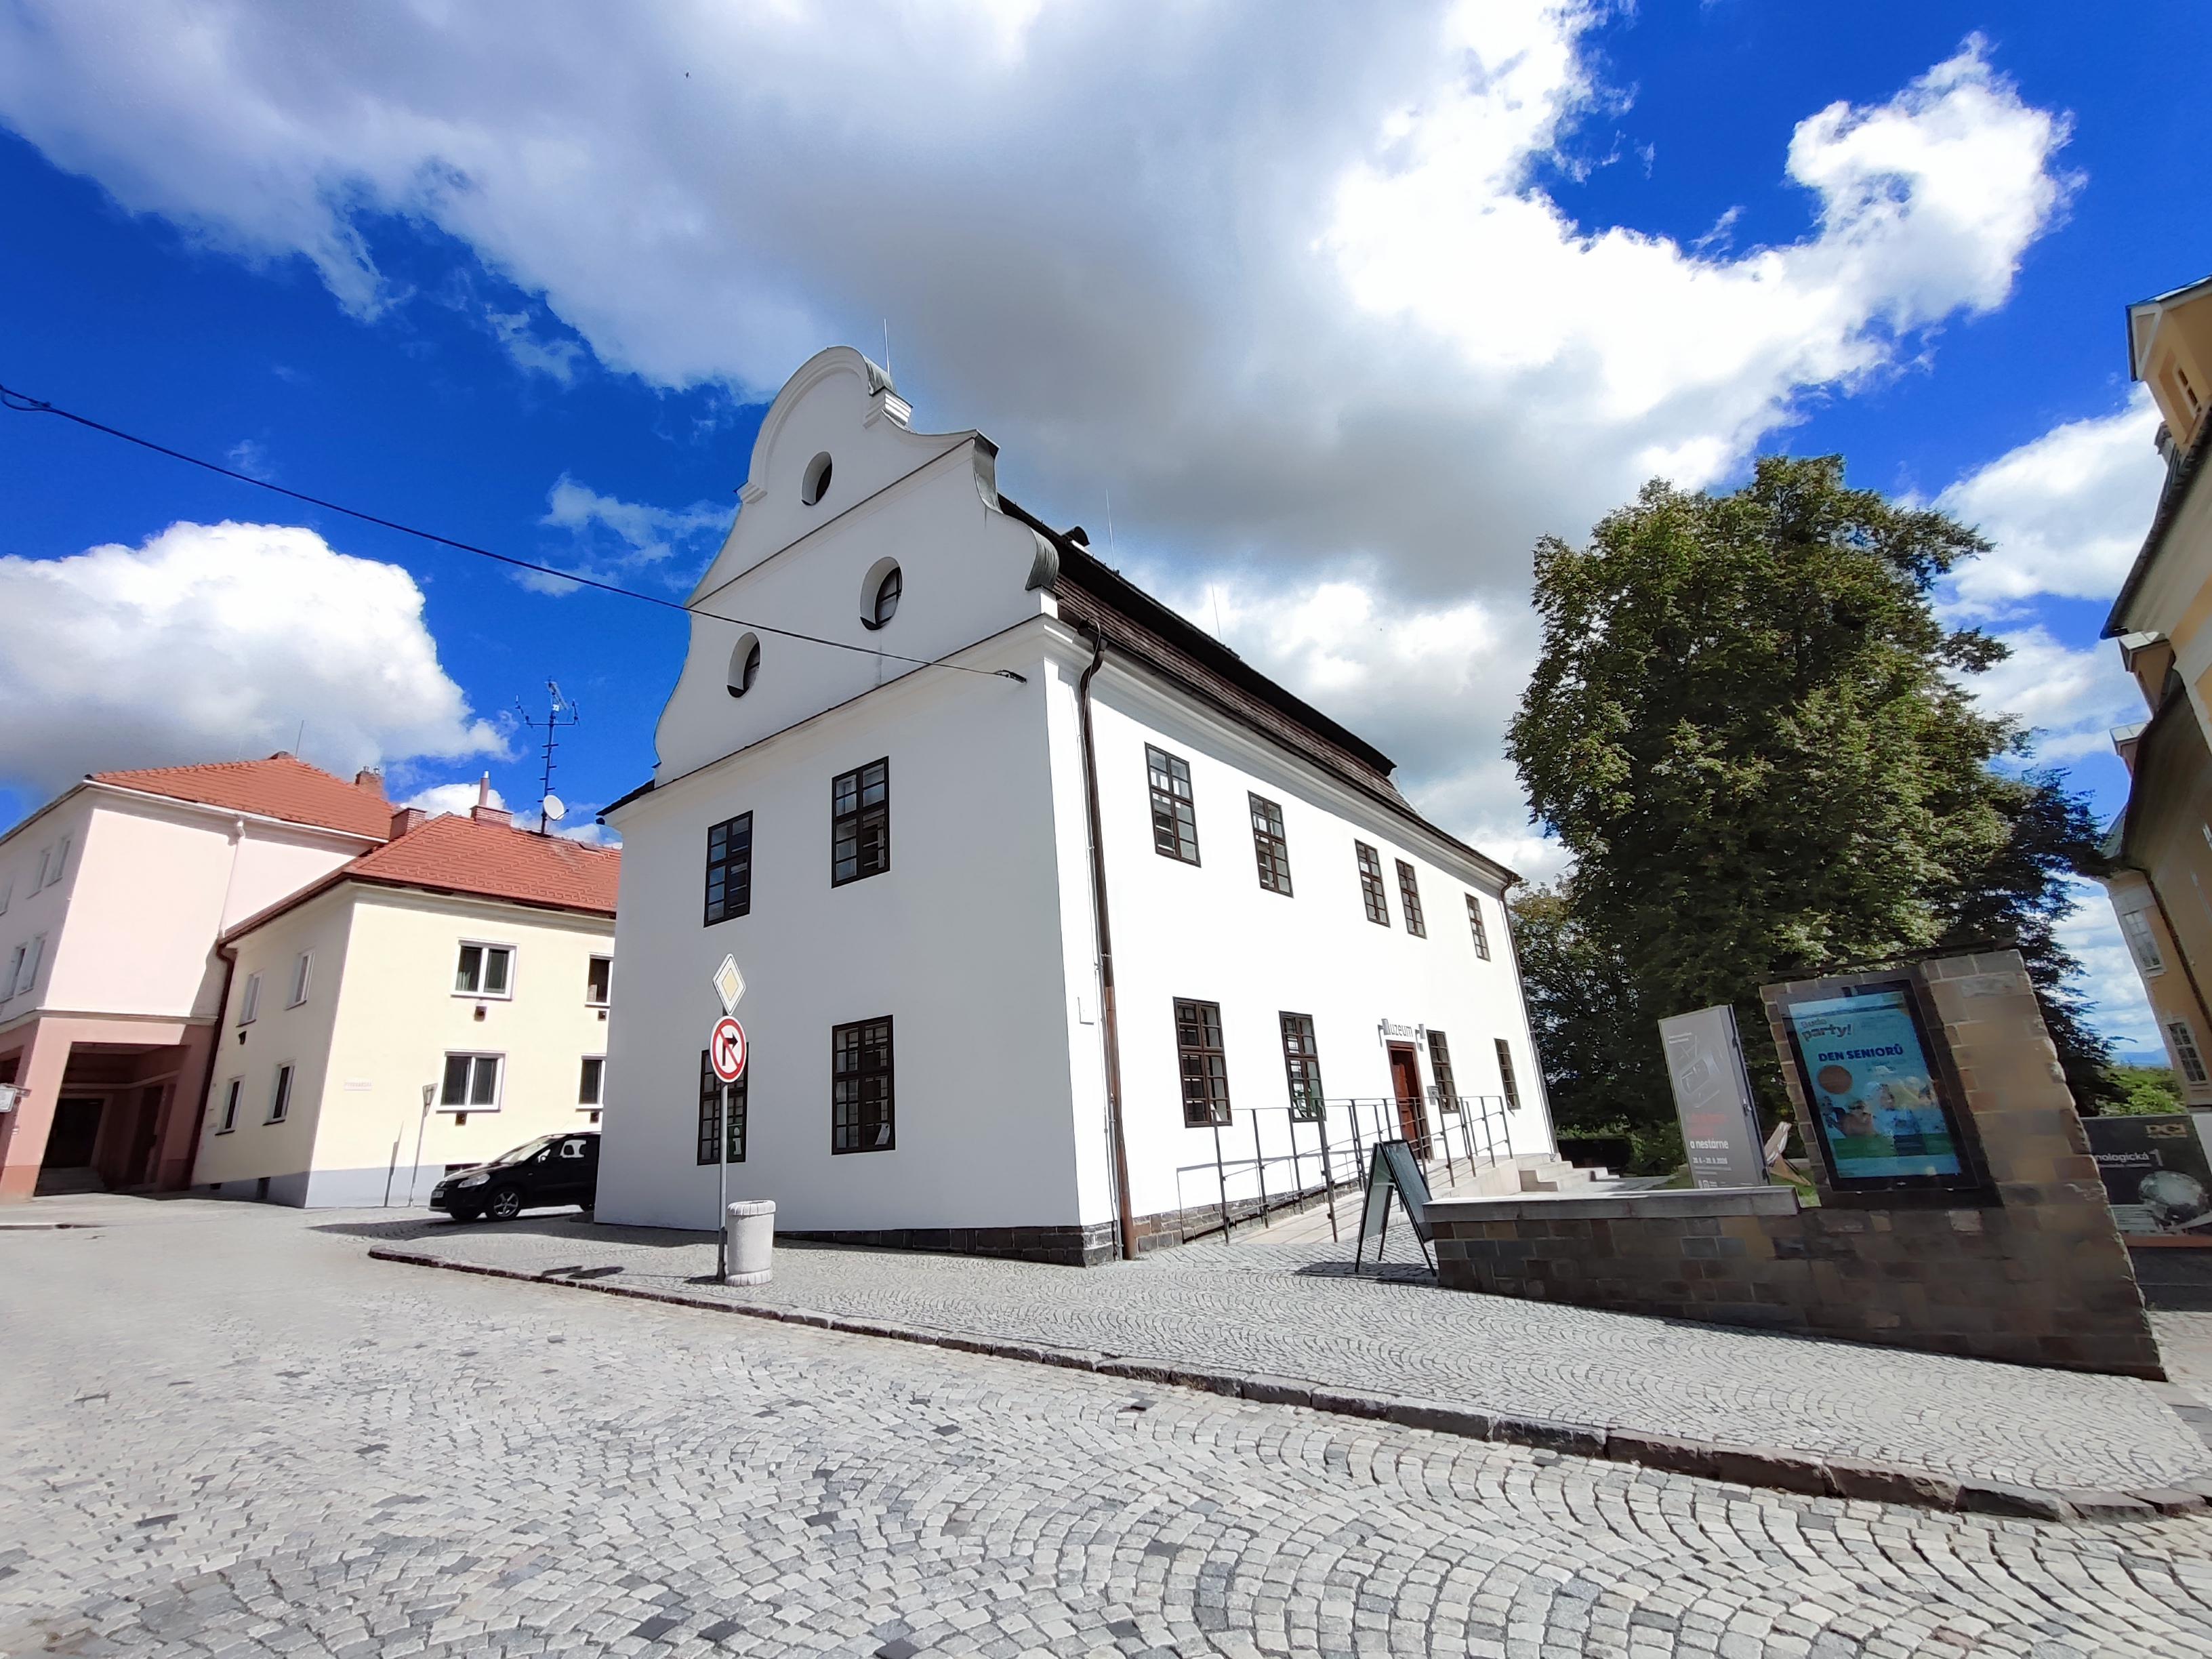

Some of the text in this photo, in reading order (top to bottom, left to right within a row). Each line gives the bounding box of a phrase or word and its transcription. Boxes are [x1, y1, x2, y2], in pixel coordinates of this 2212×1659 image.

[1385, 1023, 1413, 1037] uzeum
[1801, 1024, 1852, 1042] party!
[1818, 1044, 1904, 1062] DEN SENIORŮ
[1689, 1139, 1729, 1149] a nestárne
